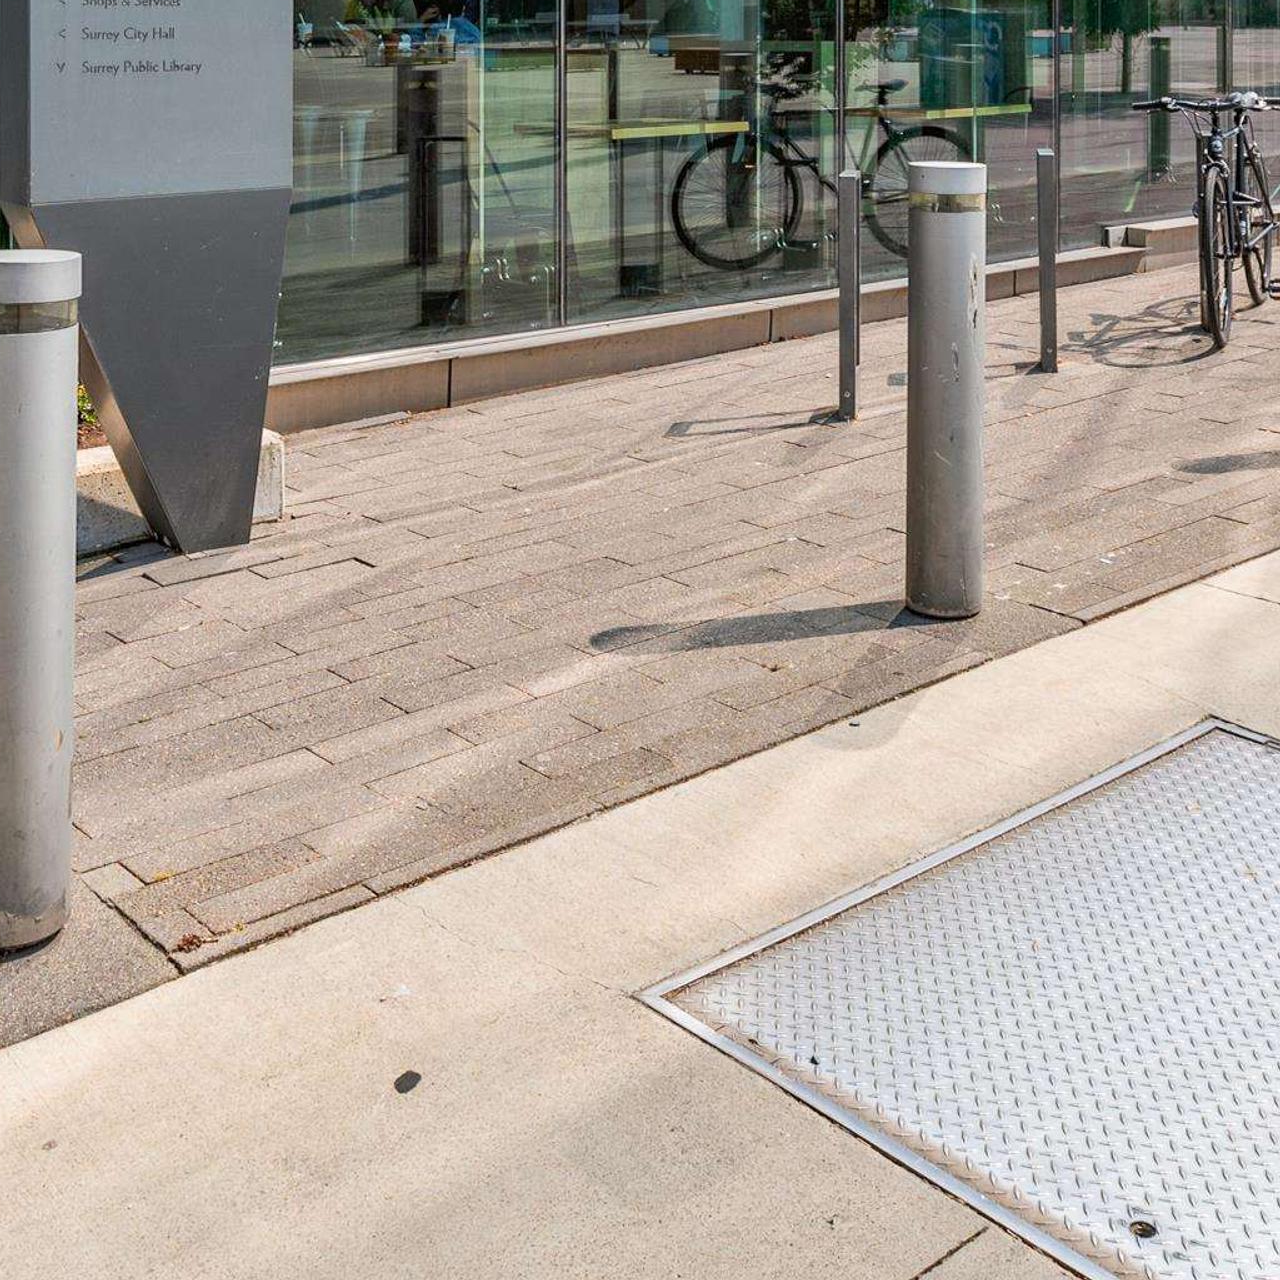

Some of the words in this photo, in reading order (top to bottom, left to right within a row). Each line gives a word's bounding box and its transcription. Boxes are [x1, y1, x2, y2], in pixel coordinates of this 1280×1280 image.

[81, 26, 120, 43] Surrey
[123, 27, 149, 43] City
[152, 27, 175, 39] Hall
[81, 60, 120, 77] Surrey
[123, 60, 160, 73] Public
[162, 61, 202, 75] Library
